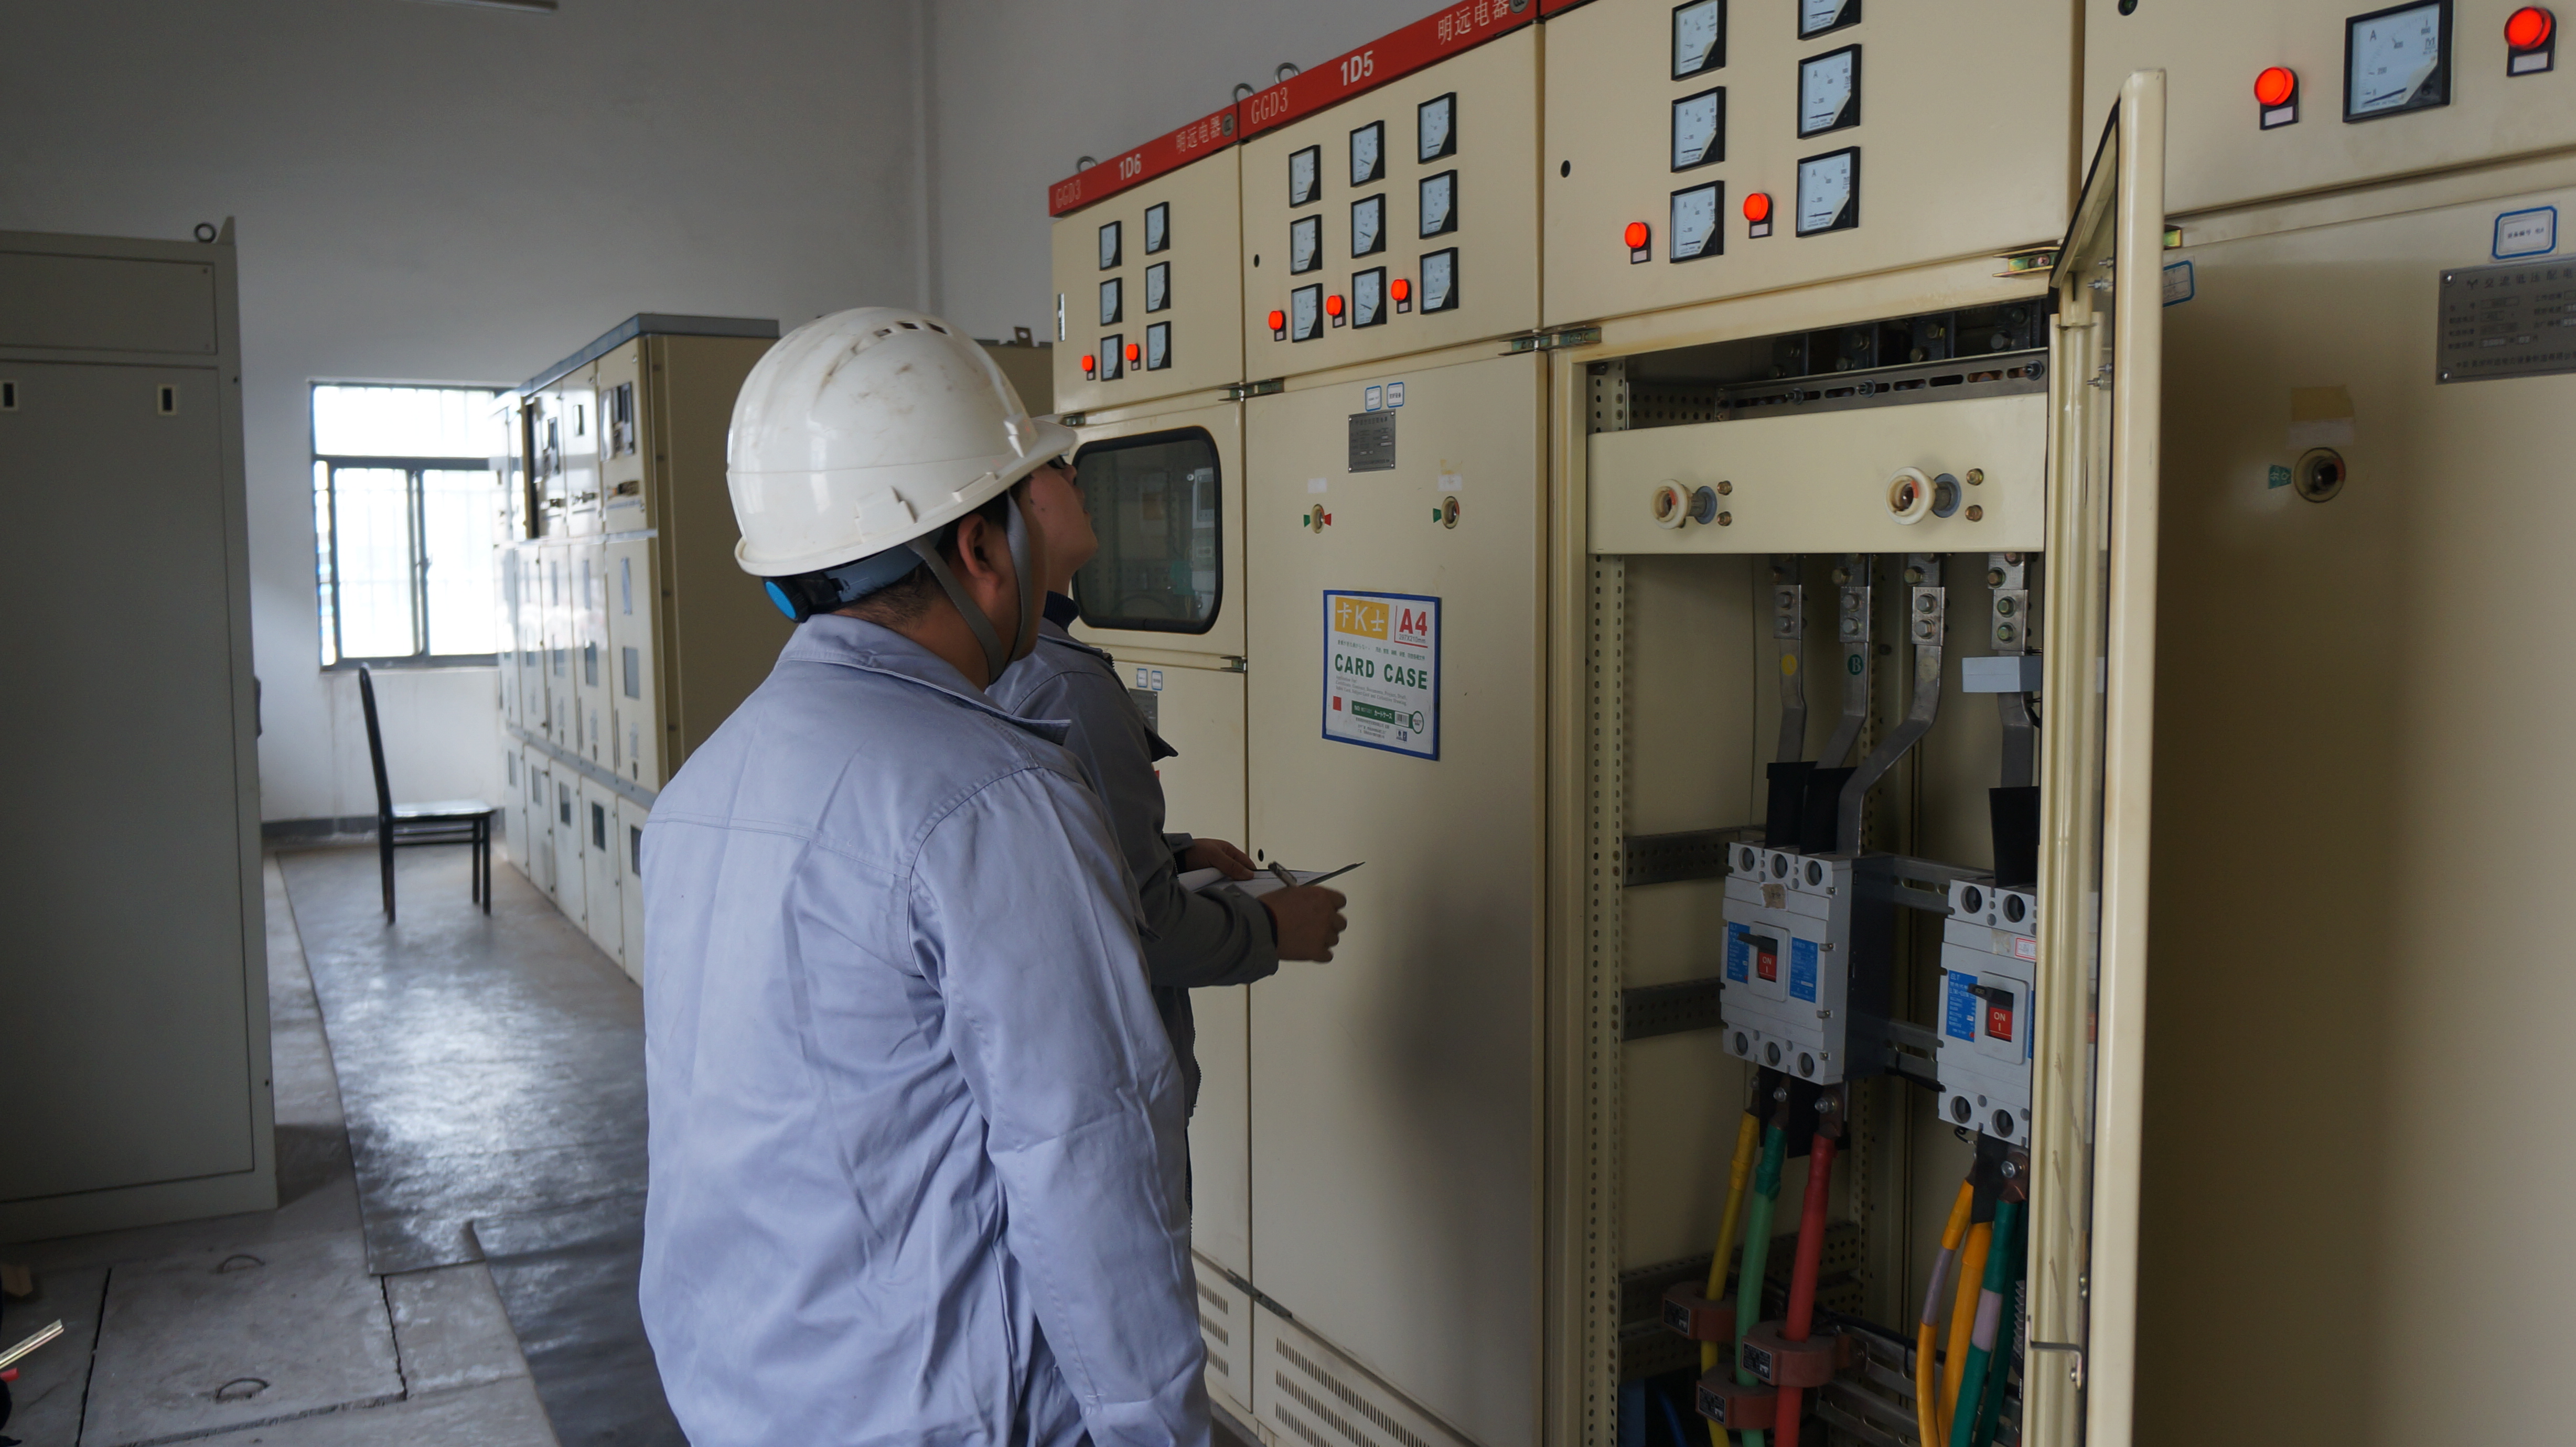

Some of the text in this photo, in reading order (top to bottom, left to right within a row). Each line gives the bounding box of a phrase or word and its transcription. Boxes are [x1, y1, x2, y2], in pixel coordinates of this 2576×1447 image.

[1438, 0, 1509, 45] 明远电器
[1340, 50, 1374, 87] 1D5
[1251, 87, 1289, 124] GGD3
[1175, 115, 1221, 155] 明远电器
[1119, 153, 1142, 181] 1D6
[1055, 179, 1081, 209] GGD3
[1399, 608, 1427, 637] A4
[1334, 653, 1427, 690] CARD CASE
[1852, 657, 1862, 672] B
[1762, 956, 1772, 965] ON
[1993, 1011, 2006, 1022] ON
